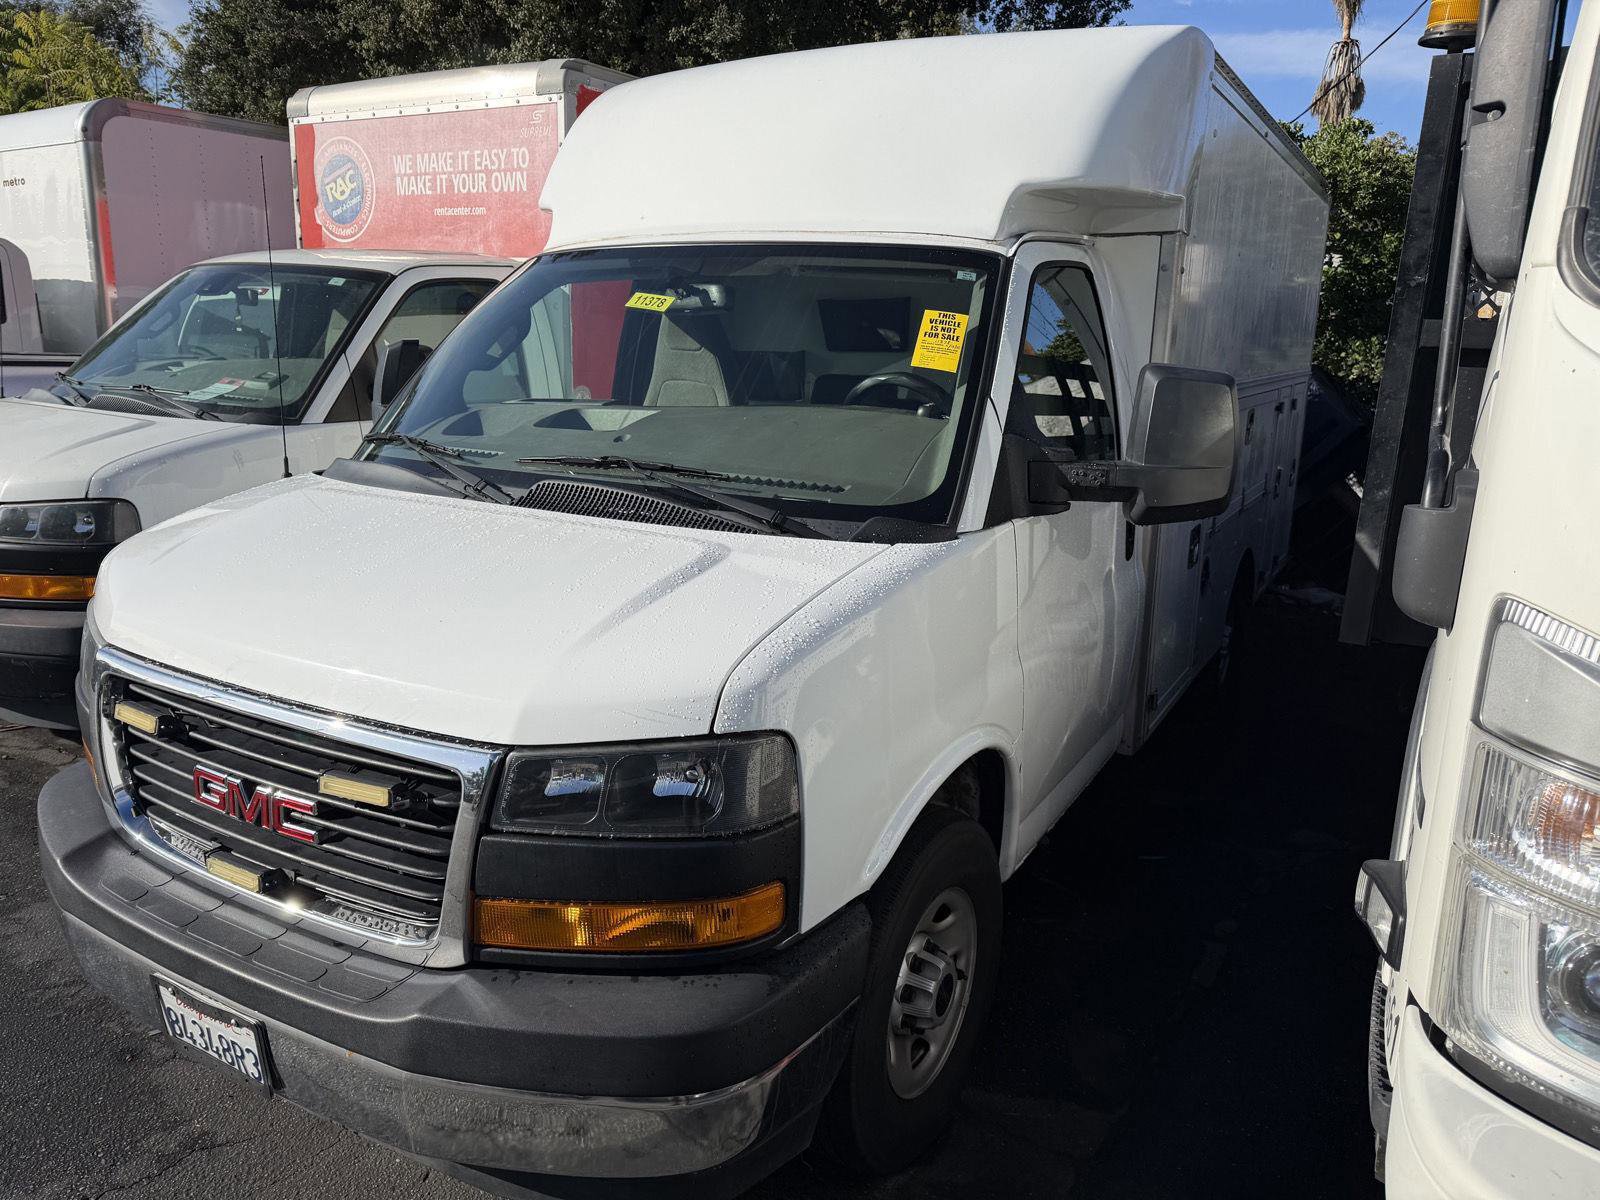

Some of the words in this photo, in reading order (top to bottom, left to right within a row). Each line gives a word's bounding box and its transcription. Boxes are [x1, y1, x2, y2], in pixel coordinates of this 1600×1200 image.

[393, 153, 413, 174] WE
[416, 151, 454, 173] MAKE
[458, 150, 471, 171] IT
[474, 148, 508, 170] EASY
[511, 147, 530, 168] TO
[2, 176, 26, 188] metro
[396, 174, 432, 196] MAKE
[436, 173, 448, 195] IT
[451, 172, 488, 194] YOUR
[491, 171, 527, 193] OWN
[433, 206, 487, 217] rentacenter.com
[634, 295, 667, 308] 11378
[929, 318, 961, 328] VEHICLE
[923, 331, 940, 339] FOR
[941, 333, 960, 342] SALE
[193, 764, 319, 845] GMC
[166, 1006, 262, 1084] 84348R3
